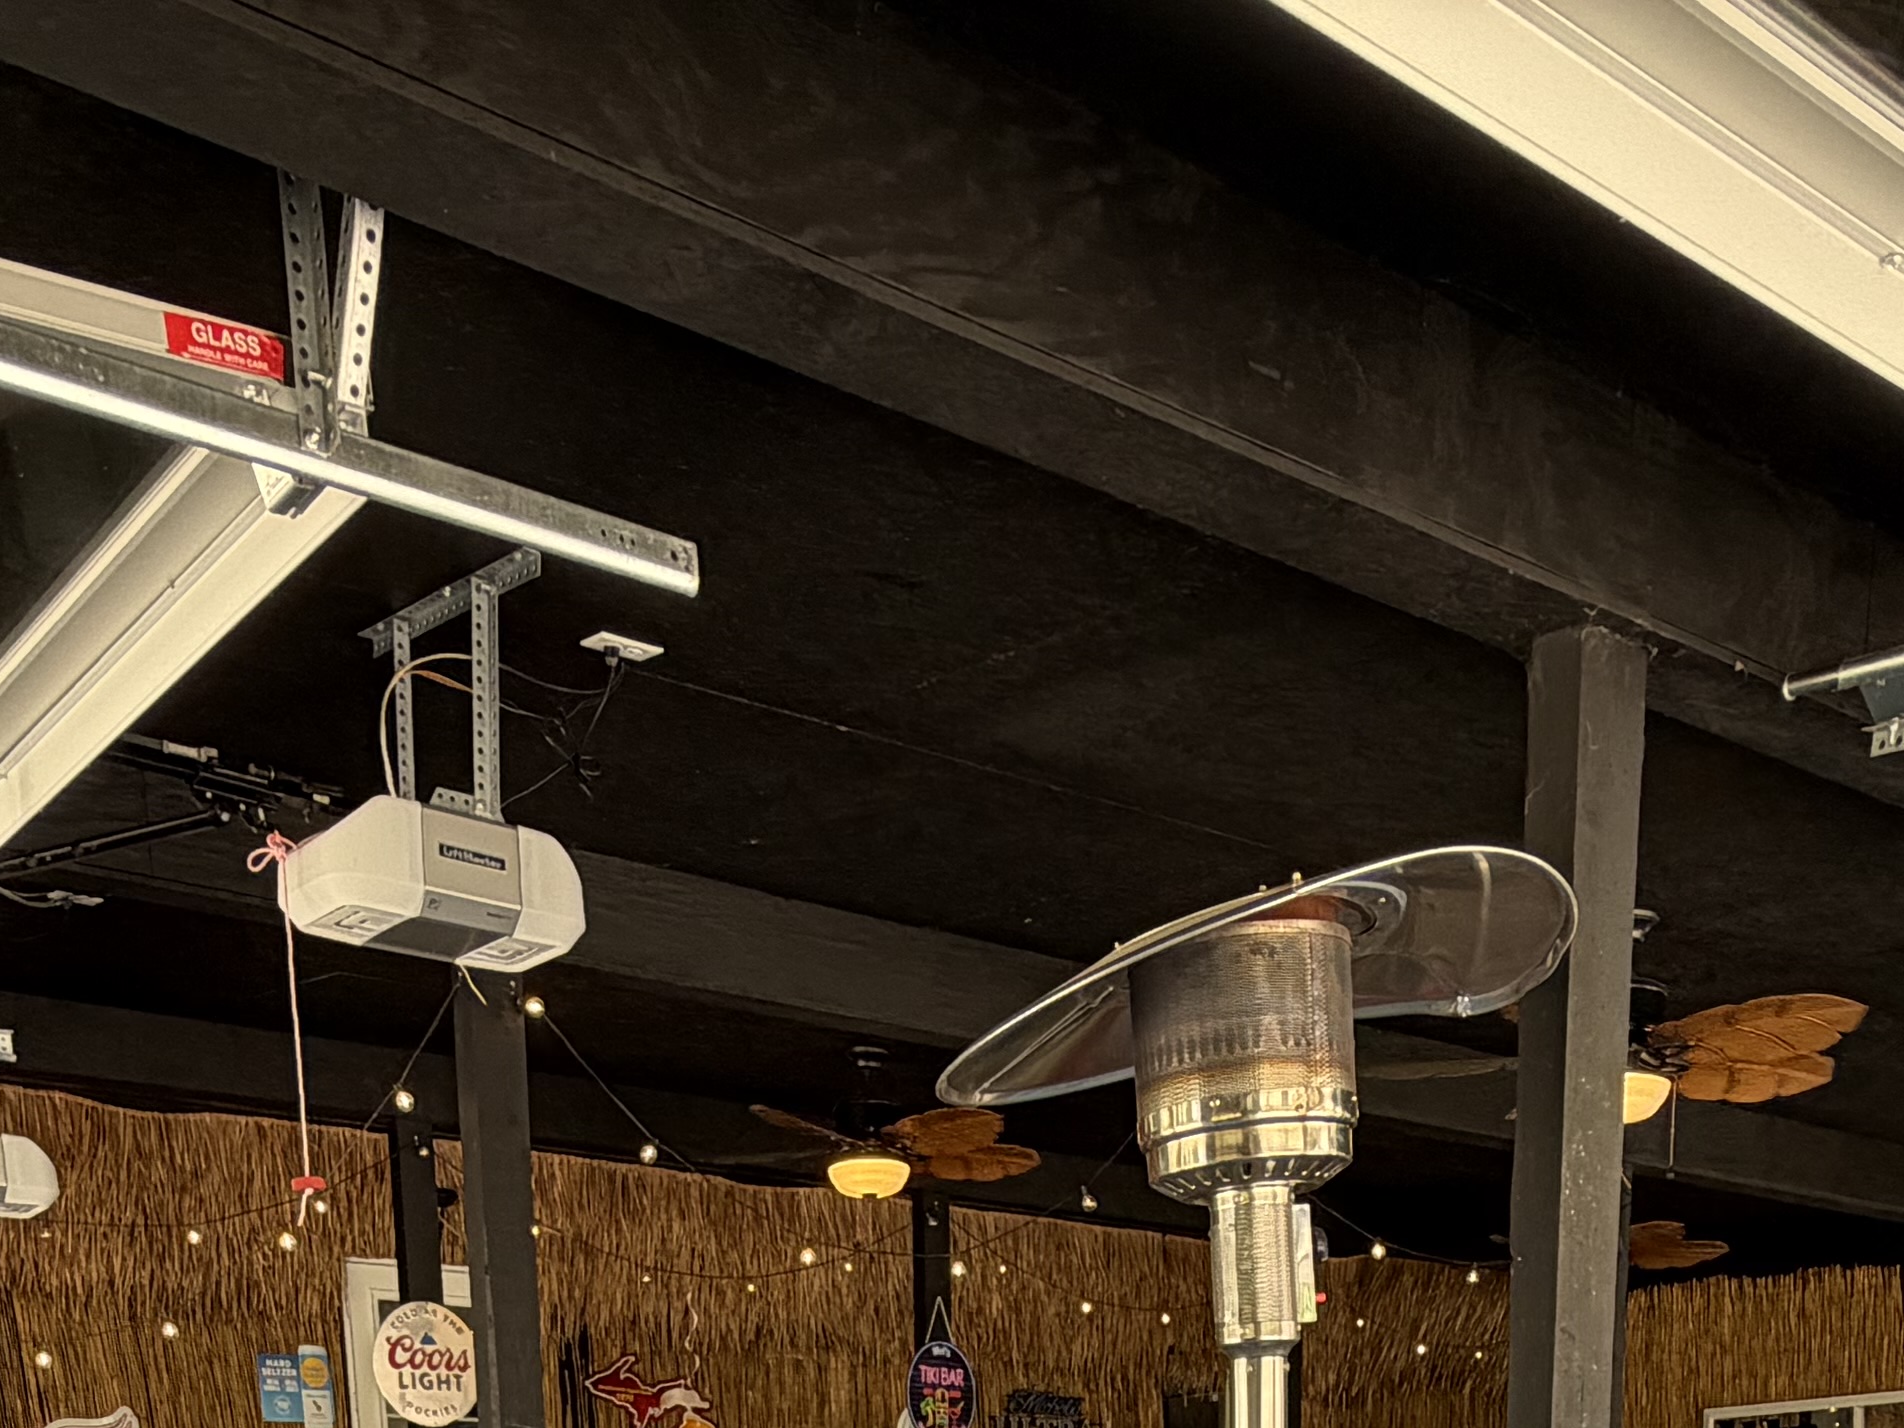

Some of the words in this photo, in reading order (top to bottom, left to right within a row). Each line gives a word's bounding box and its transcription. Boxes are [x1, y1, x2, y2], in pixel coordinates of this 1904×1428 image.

[191, 321, 262, 357] GLASS
[385, 1334, 472, 1373] Coors
[398, 1370, 464, 1392] LIGHT
[919, 1364, 941, 1384] TIKI
[940, 1366, 965, 1388] BAR
